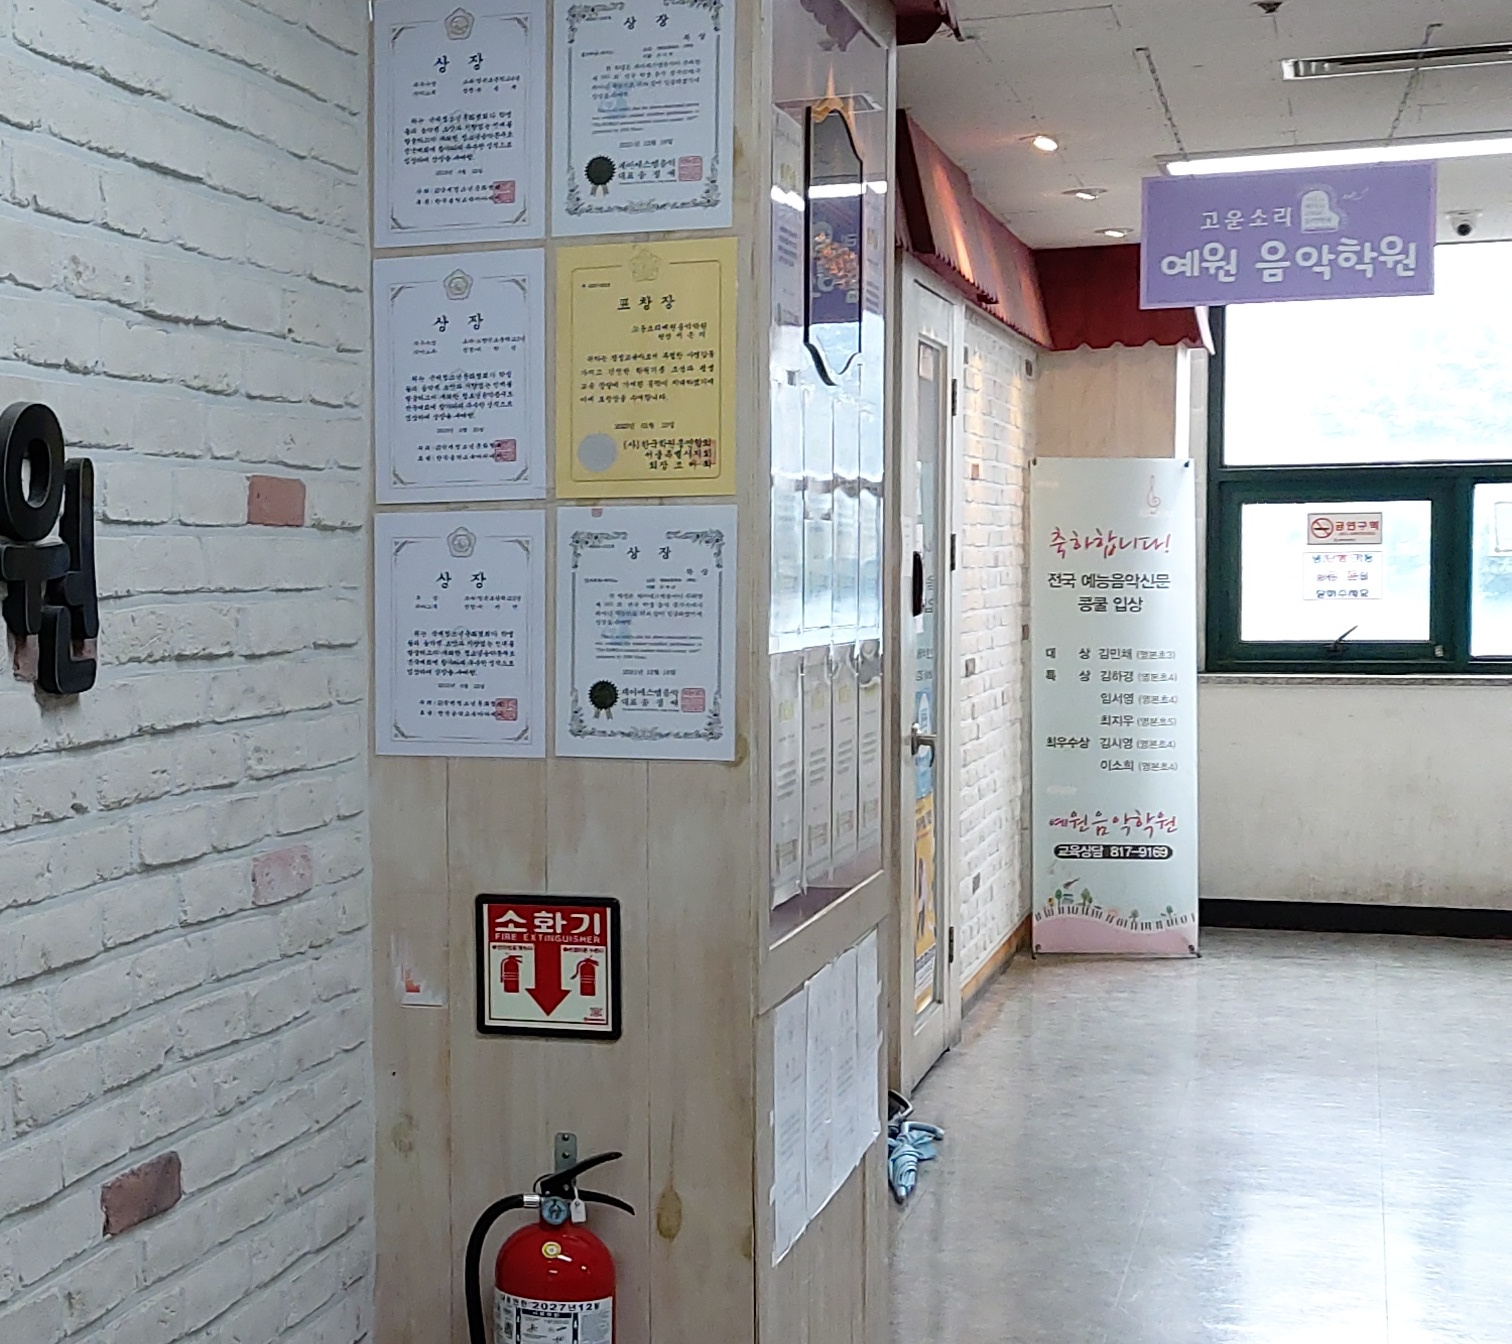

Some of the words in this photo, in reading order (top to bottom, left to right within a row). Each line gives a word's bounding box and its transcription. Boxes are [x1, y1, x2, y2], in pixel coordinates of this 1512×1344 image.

[1199, 207, 1292, 230] 고운소리
[1161, 242, 1237, 282] 예원
[1255, 235, 1417, 283] 음악학원
[1335, 521, 1379, 531] 금연구역
[1049, 527, 1171, 559] 축하합니다!
[1047, 573, 1077, 588] 전국
[1081, 573, 1171, 589] 예능음악신문
[1078, 596, 1108, 612] 콩쿨
[1113, 596, 1143, 613] 입상
[1049, 809, 1178, 838] 예원음악학원
[1057, 845, 1104, 858] 교육상담
[494, 910, 601, 935] 소화기
[495, 932, 517, 941] FIRE
[523, 933, 601, 944] EXTINGUISHER
